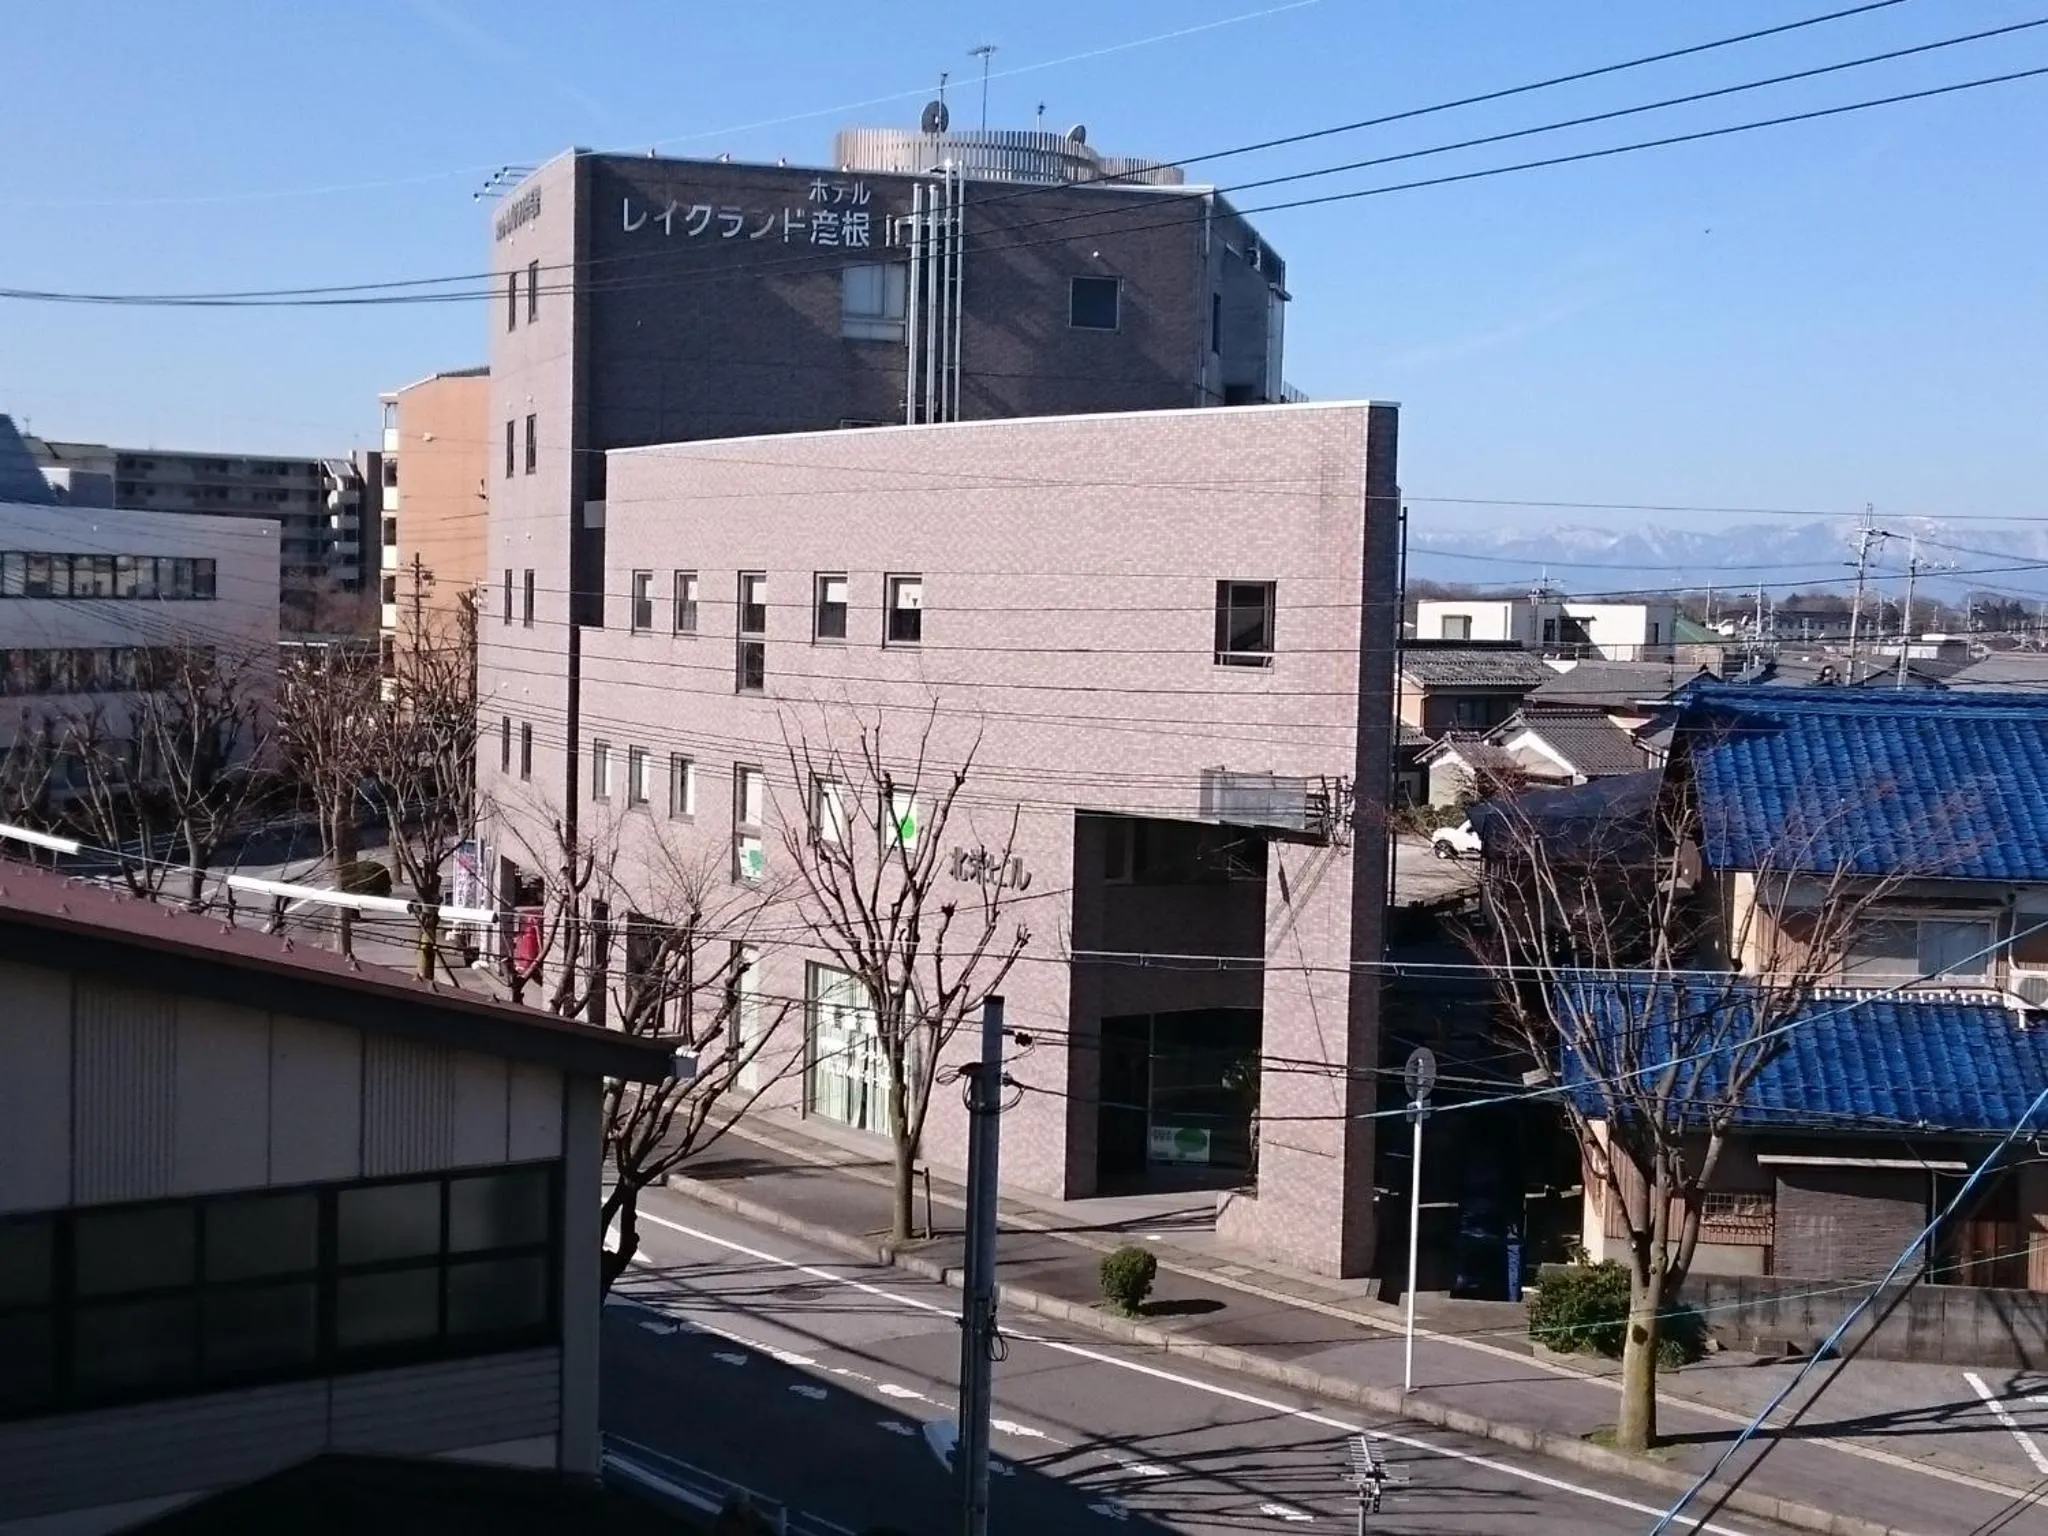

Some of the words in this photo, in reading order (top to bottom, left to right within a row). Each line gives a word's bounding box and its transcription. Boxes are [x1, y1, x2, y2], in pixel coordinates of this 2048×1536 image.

[810, 178, 871, 205] ホテル
[623, 198, 870, 247] レイクランド彦根
